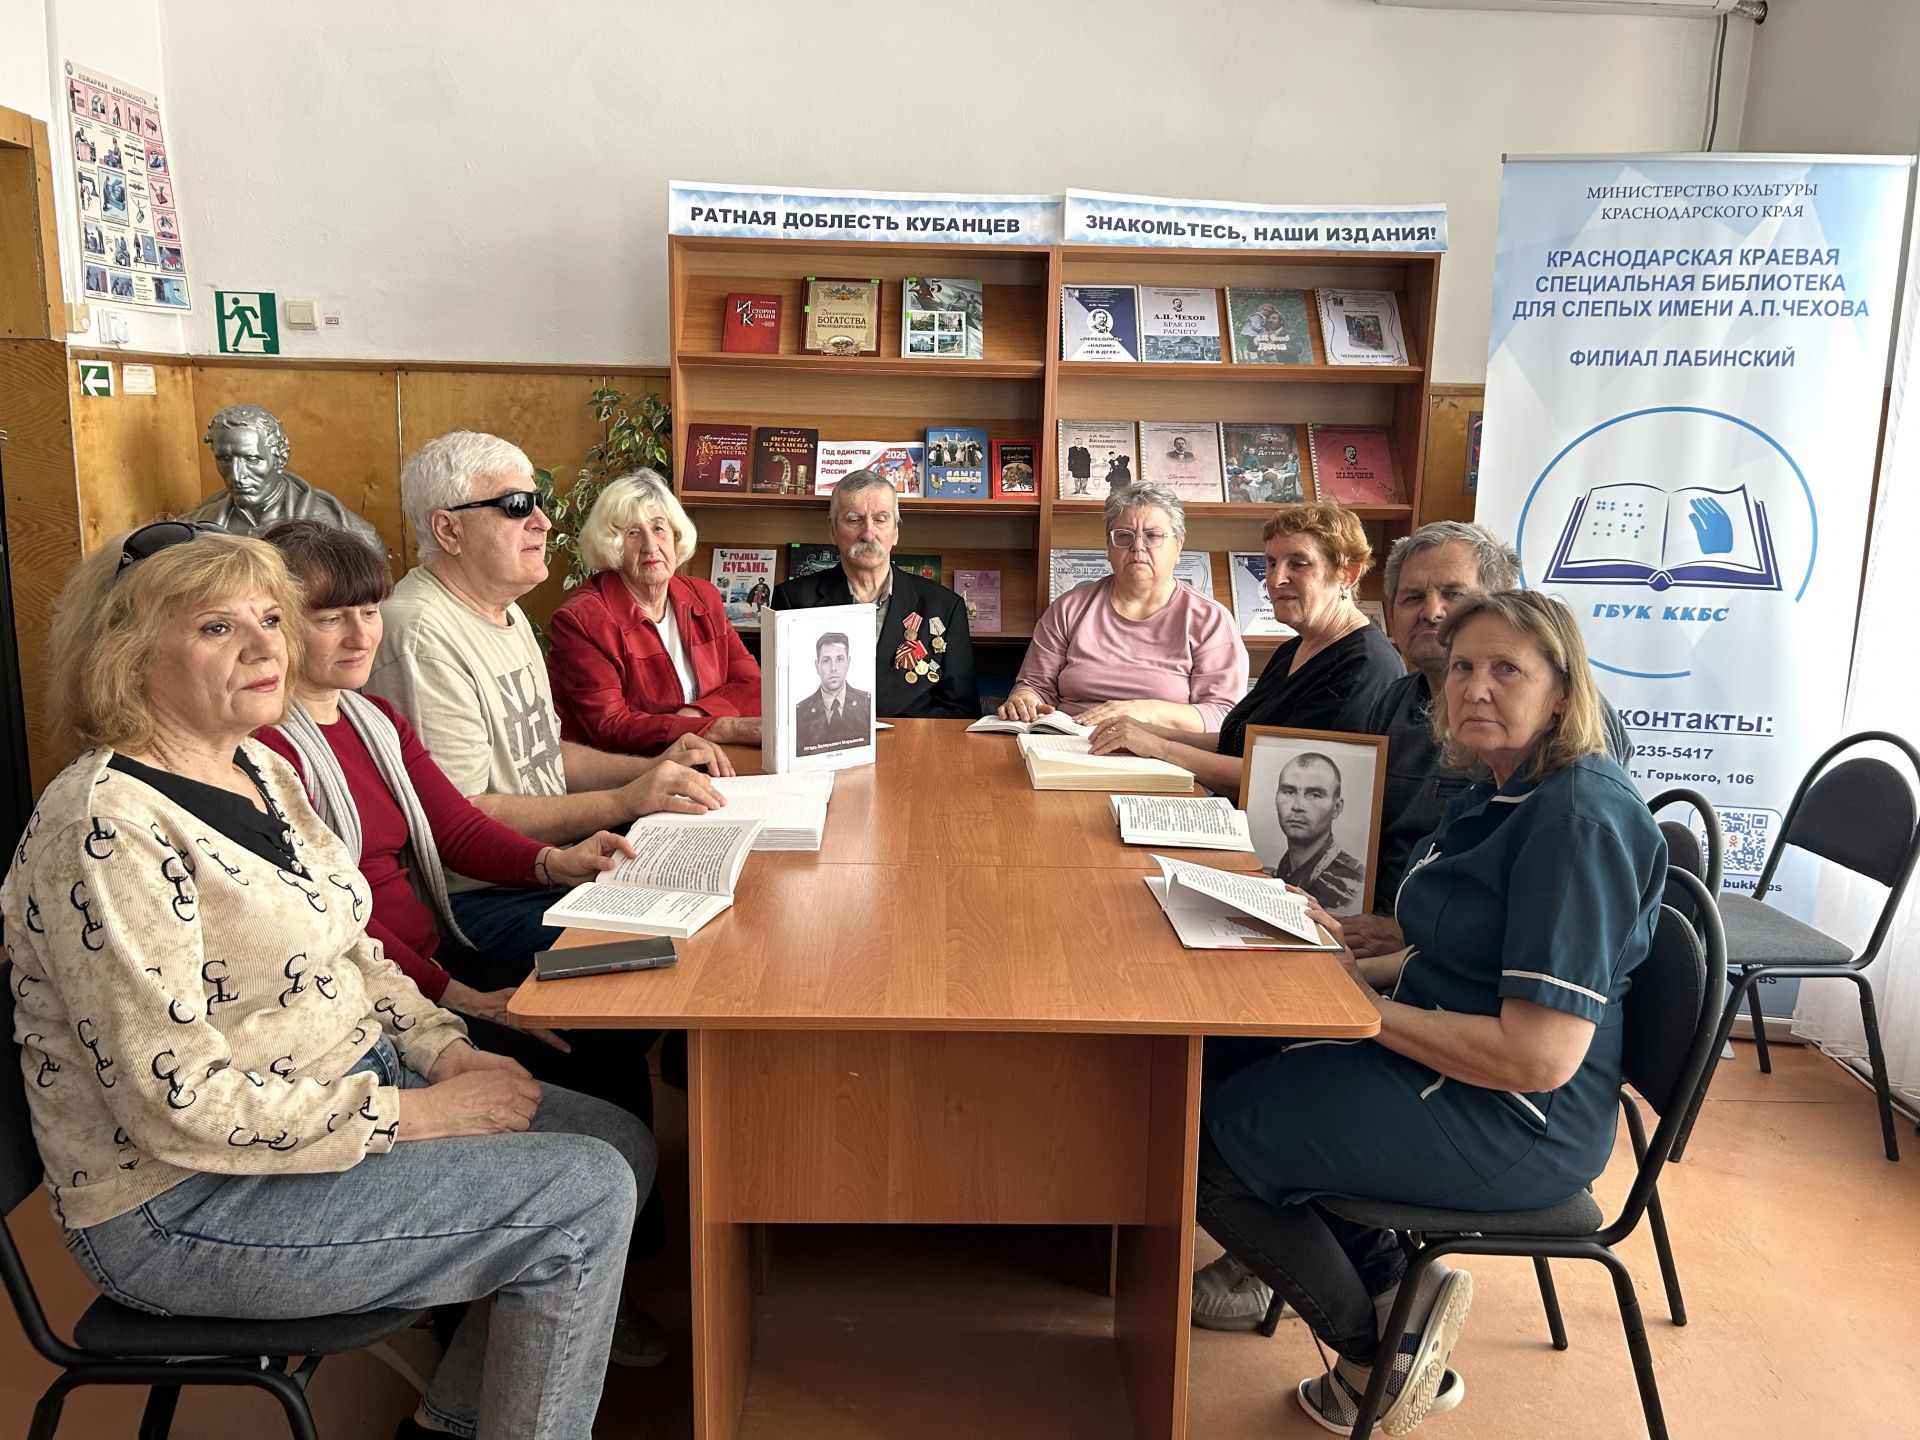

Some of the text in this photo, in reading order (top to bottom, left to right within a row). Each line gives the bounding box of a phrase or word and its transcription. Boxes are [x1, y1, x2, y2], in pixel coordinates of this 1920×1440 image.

[1586, 183, 1818, 199] МИНИСТЕРСТВО КУЛЬТУРЫ
[690, 206, 1020, 234] РАТНАЯ ДОБЛЕСТЬ КУБАНЦЕВ
[1601, 205, 1804, 221] КРАСНОДАРСКОГО КРАЯ
[1085, 215, 1437, 243] ЗНАКОМЬТЕСЬ, НАШИ ИЗДАНИЯ!
[1547, 248, 1840, 269] КРАСНОДАРСКАЯ КРАЕВАЯ
[1535, 274, 1846, 295] СПЕЦИАЛЬНАЯ БИБЛИОТЕКА
[737, 300, 776, 315] ИСТОРИЯ
[1513, 300, 1869, 320] ДЛЯ СЛЕПЫХ ИМЕНИ А.П.ЧЕХОВА
[742, 313, 776, 326] КУБАНИ
[817, 316, 867, 325] БОГАТСТВА
[1569, 346, 1795, 367] ФИЛИАЛ ЛАБИНСКИЙ
[822, 448, 871, 457] Год единства
[886, 450, 907, 460] 2026
[821, 467, 848, 475] России
[729, 552, 759, 560] РОДНАЯ
[722, 561, 769, 574] КУБАНЬ
[1592, 603, 1730, 622] ГБУК ККБС
[1630, 744, 1714, 760] )235-5417
[1647, 769, 1721, 785] Горького,
[1727, 774, 1755, 785] 106
